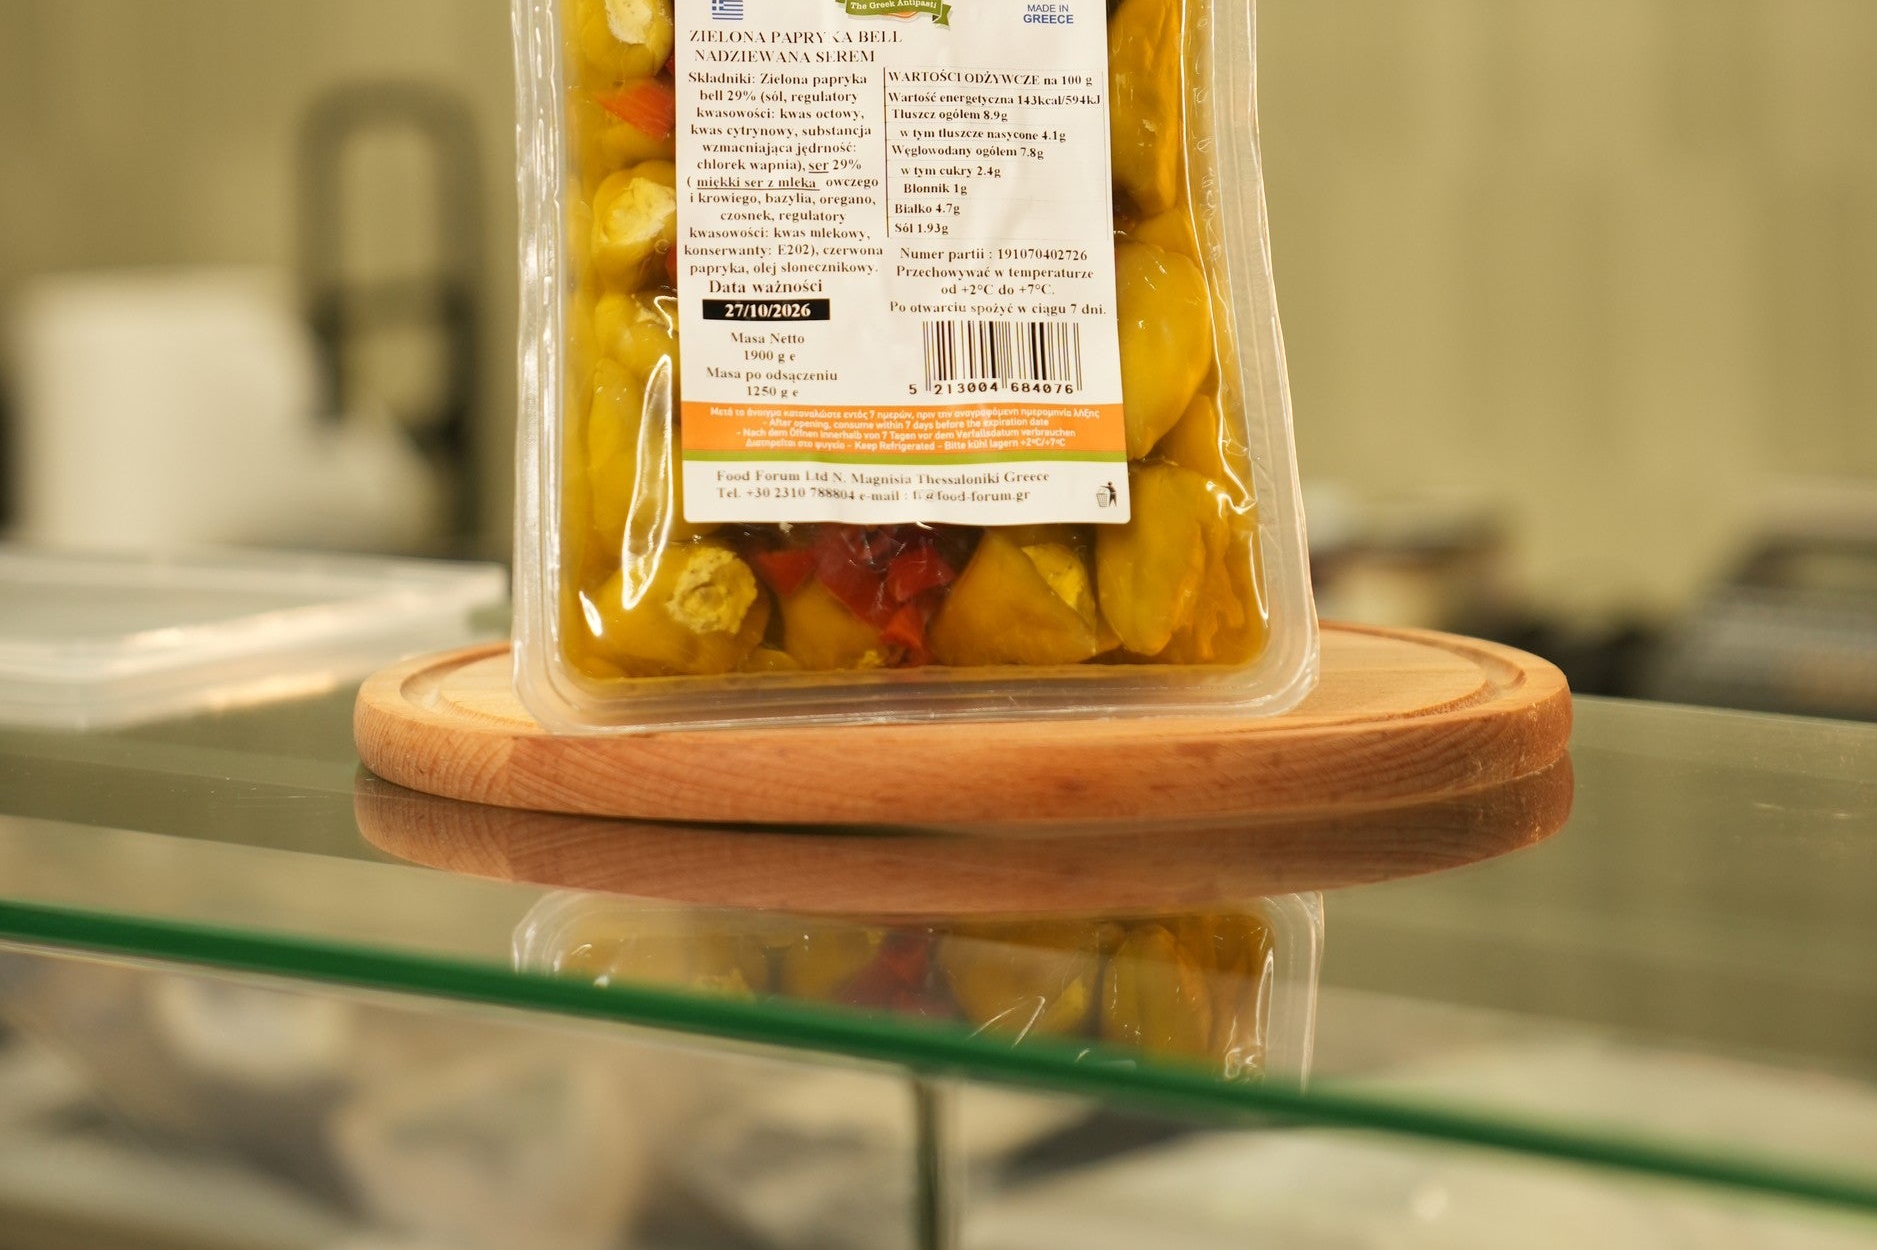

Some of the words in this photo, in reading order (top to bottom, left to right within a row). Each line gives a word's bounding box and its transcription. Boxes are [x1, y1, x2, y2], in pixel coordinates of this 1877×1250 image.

[870, 0, 895, 9] Greek
[897, 0, 937, 9] Antipasti
[1023, 14, 1073, 24] GREECE
[689, 30, 765, 43] ZIELONA
[859, 30, 902, 43] BELL
[695, 50, 810, 63] NADZIEWANA
[816, 50, 875, 62] SEREM
[760, 73, 808, 84] Zielona
[813, 74, 867, 87] papryka
[889, 69, 961, 82] WARTOŚCI
[964, 71, 1040, 85] ODŻYWCZE
[1044, 77, 1057, 85] na
[1062, 75, 1081, 85] 100
[1086, 77, 1092, 86] g
[700, 90, 723, 101] bell
[727, 91, 755, 101] 29%
[761, 91, 787, 103] (sól,
[791, 91, 858, 104] regulatory
[889, 92, 936, 102] Wartość
[940, 94, 1014, 106] energetyczna
[1018, 95, 1100, 105] 143kcal/594kJ
[697, 107, 775, 118] kwasowości:
[780, 108, 812, 118] kwas
[816, 109, 864, 121] octowy,
[984, 111, 1008, 122] 8.9g
[691, 124, 722, 135] kwas
[727, 126, 798, 138] cytrynowy,
[802, 125, 871, 138] substancja
[900, 129, 909, 137] w
[913, 129, 934, 140] tym
[987, 130, 1038, 141] nasycone
[1042, 131, 1066, 142] 4.1g
[703, 144, 793, 156] wzmacniająca
[796, 142, 856, 156] jędrność:
[1020, 147, 1044, 160] 7.8g
[697, 159, 745, 170] chlorek
[750, 160, 805, 172] wapnia),
[808, 161, 829, 171] ser
[833, 159, 861, 170] 29%
[901, 167, 909, 175] w
[915, 167, 936, 177] tym
[940, 166, 972, 177] cukry
[977, 166, 1001, 178] 2.4g
[697, 177, 740, 189] miękki
[744, 179, 763, 188] ser
[768, 180, 774, 188] z
[779, 177, 816, 188] mleka
[826, 179, 878, 188] owczego
[954, 183, 967, 195] 1g
[699, 193, 761, 206] krowiego,
[766, 194, 815, 206] bazylia,
[820, 195, 876, 206] oregano,
[936, 204, 960, 215] 4.7g
[721, 210, 774, 221] czosnek,
[779, 210, 846, 224] regulatory
[689, 227, 768, 238] kwasowości:
[774, 228, 805, 238] kwas
[811, 228, 870, 240] mlekowy,
[895, 223, 913, 233] Sól
[917, 223, 949, 235] 1.93g
[684, 245, 772, 258] konserwanty:
[778, 244, 819, 256] E202),
[823, 246, 883, 255] czerwona
[900, 248, 944, 260] Numer
[949, 248, 984, 262] partii
[998, 249, 1087, 261] 191070402726
[690, 263, 749, 276] papryka,
[754, 263, 776, 275] olej
[897, 266, 990, 280] Przechowywać
[994, 269, 1003, 277] w
[1009, 267, 1094, 280] temperaturze
[709, 280, 745, 293] Data
[753, 279, 822, 293] ważności
[942, 285, 957, 295] od
[961, 284, 994, 295] +2°C
[999, 285, 1014, 295] do
[1019, 284, 1055, 295] +7°C.
[725, 303, 811, 318] 27/10/2026
[890, 302, 906, 312] Po
[910, 303, 966, 312] otwarciu
[971, 303, 1013, 316] spożyć
[1018, 305, 1026, 313] w
[1032, 303, 1066, 316] ciągu
[1070, 304, 1077, 313] 7
[1082, 304, 1106, 314] dni.
[731, 332, 765, 344] Masa
[770, 333, 804, 344] Netto
[744, 350, 774, 361] 1900
[778, 353, 785, 363] g
[706, 367, 741, 379] Masa
[746, 371, 761, 382] po
[766, 369, 837, 383] odsączeniu
[747, 386, 776, 396] 1250
[781, 388, 787, 398] g
[909, 384, 917, 395] 5
[934, 382, 998, 395] 213004
[1011, 382, 1073, 393] 684076
[769, 418, 791, 427] After
[794, 419, 830, 431] opening,
[834, 421, 873, 429] consume
[877, 421, 903, 430] within
[906, 421, 911, 429] 7
[914, 420, 934, 430] days
[936, 419, 964, 429] before
[967, 419, 980, 428] the
[984, 419, 1027, 429] expiration
[1030, 418, 1049, 426] date
[743, 428, 766, 437] Nach
[769, 429, 787, 437] dem
[790, 428, 817, 437] Öffnen
[820, 430, 862, 440] innerhalb
[865, 432, 880, 440] von
[882, 432, 887, 440] 7
[891, 431, 916, 441] Tagen
[918, 432, 932, 440] vor
[935, 430, 954, 440] dem
[957, 429, 1019, 439] Verfallsdatum
[1022, 428, 1076, 437] verbrauchen
[855, 441, 877, 451] Keep
[880, 441, 935, 452] Refrigerated
[945, 440, 966, 450] Bitte
[968, 439, 988, 449] kühl
[990, 439, 1018, 450] lagern
[717, 470, 750, 481] Food
[756, 470, 800, 481] Forum
[806, 470, 828, 481] Ltd
[852, 473, 911, 486] Magnisia
[917, 474, 999, 485] Thessaloniki
[1004, 471, 1050, 483] Greece
[717, 487, 740, 499] Tel.
[746, 487, 769, 498] +30
[775, 487, 805, 497] 2310
[811, 487, 854, 500] 788804
[860, 491, 900, 501] e-mail
